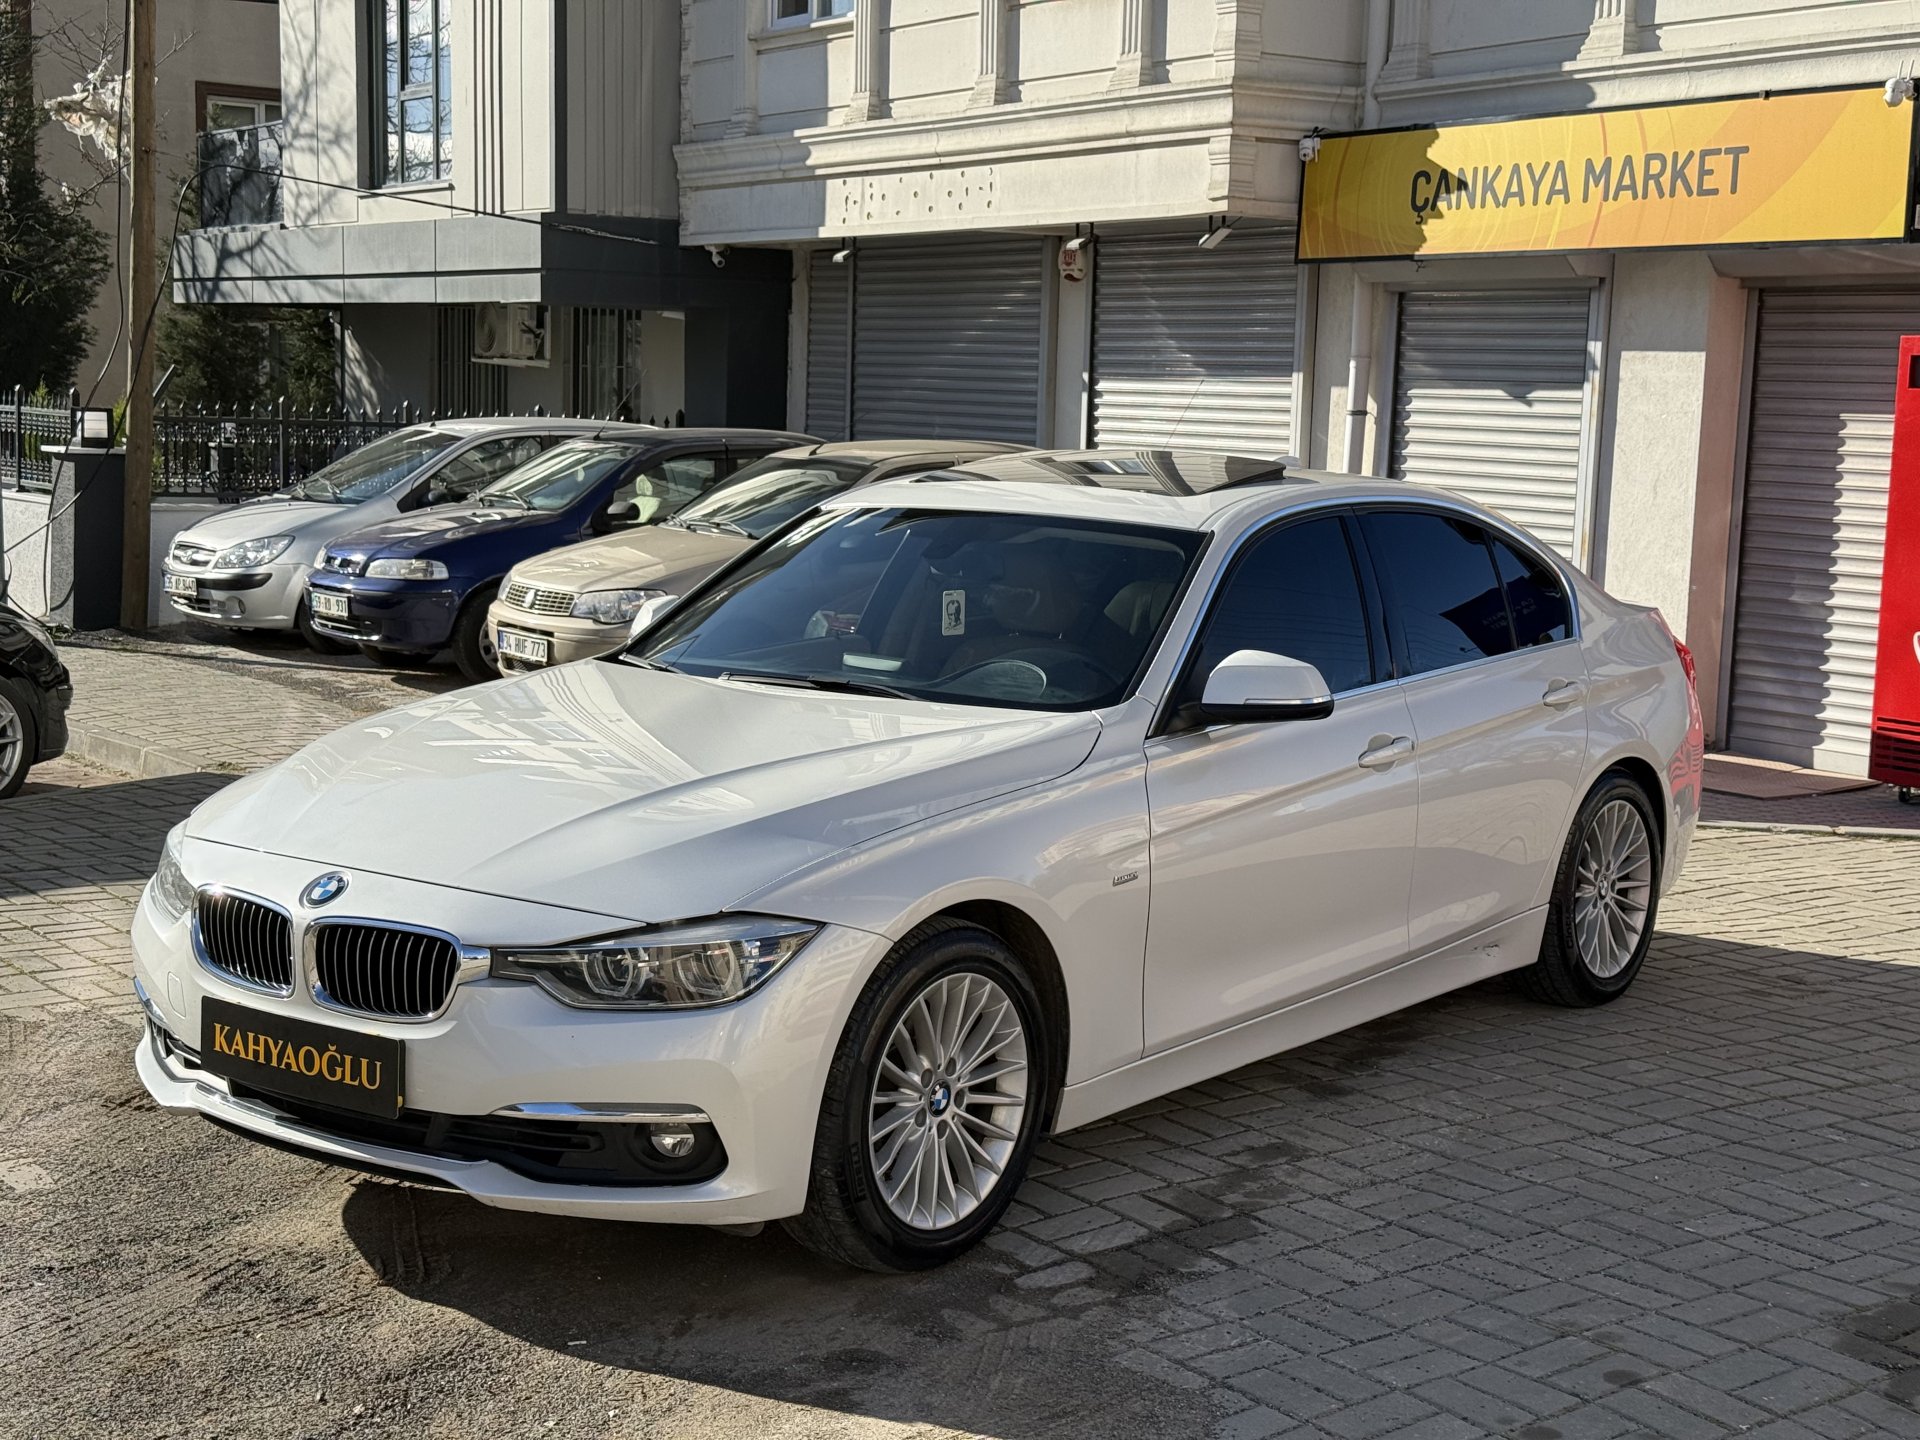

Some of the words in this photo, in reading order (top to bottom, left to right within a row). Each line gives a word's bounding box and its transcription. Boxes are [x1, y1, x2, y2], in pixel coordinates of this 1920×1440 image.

[1410, 159, 1571, 225] ÇANKAYA
[1582, 146, 1750, 204] MARKET
[336, 598, 347, 614] 931
[531, 640, 546, 658] 773
[213, 1022, 382, 1090] KAHYAOĞLU
